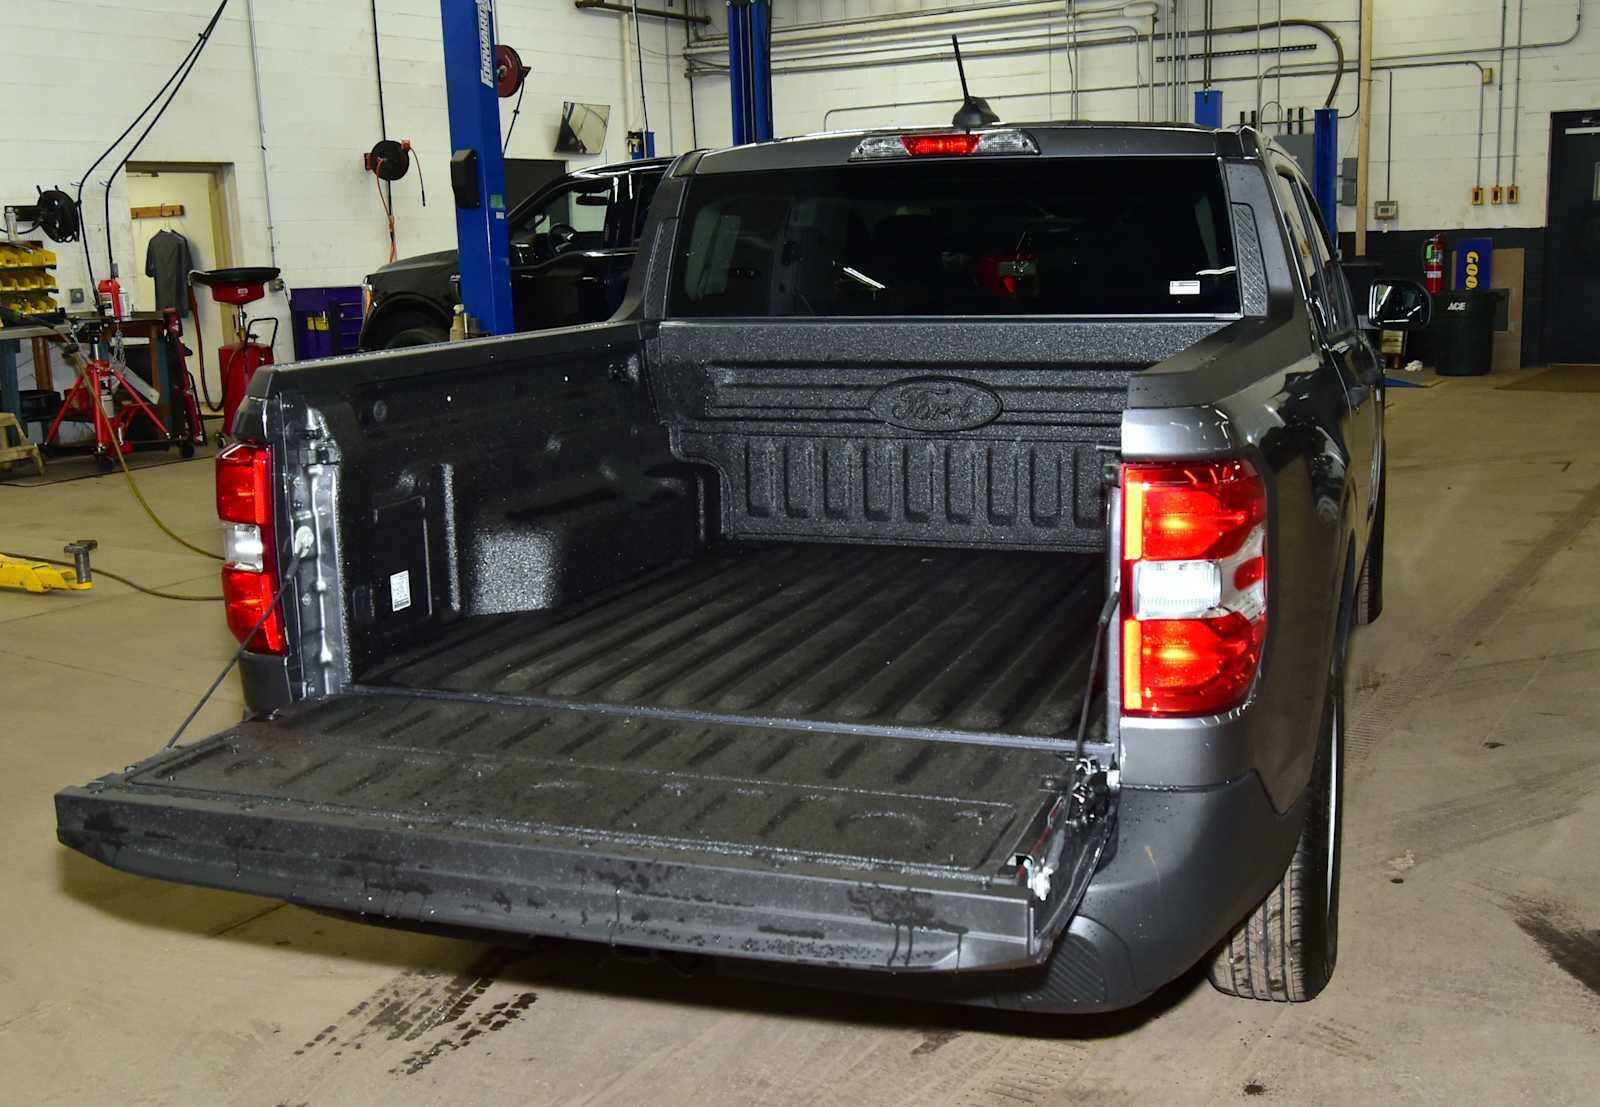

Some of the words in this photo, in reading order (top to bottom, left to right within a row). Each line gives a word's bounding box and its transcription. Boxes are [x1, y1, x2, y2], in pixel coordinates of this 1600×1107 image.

[478, 2, 494, 88] FORWARD
[1465, 251, 1478, 290] GOO
[1447, 302, 1466, 311] ACE
[891, 385, 977, 421] Ford
